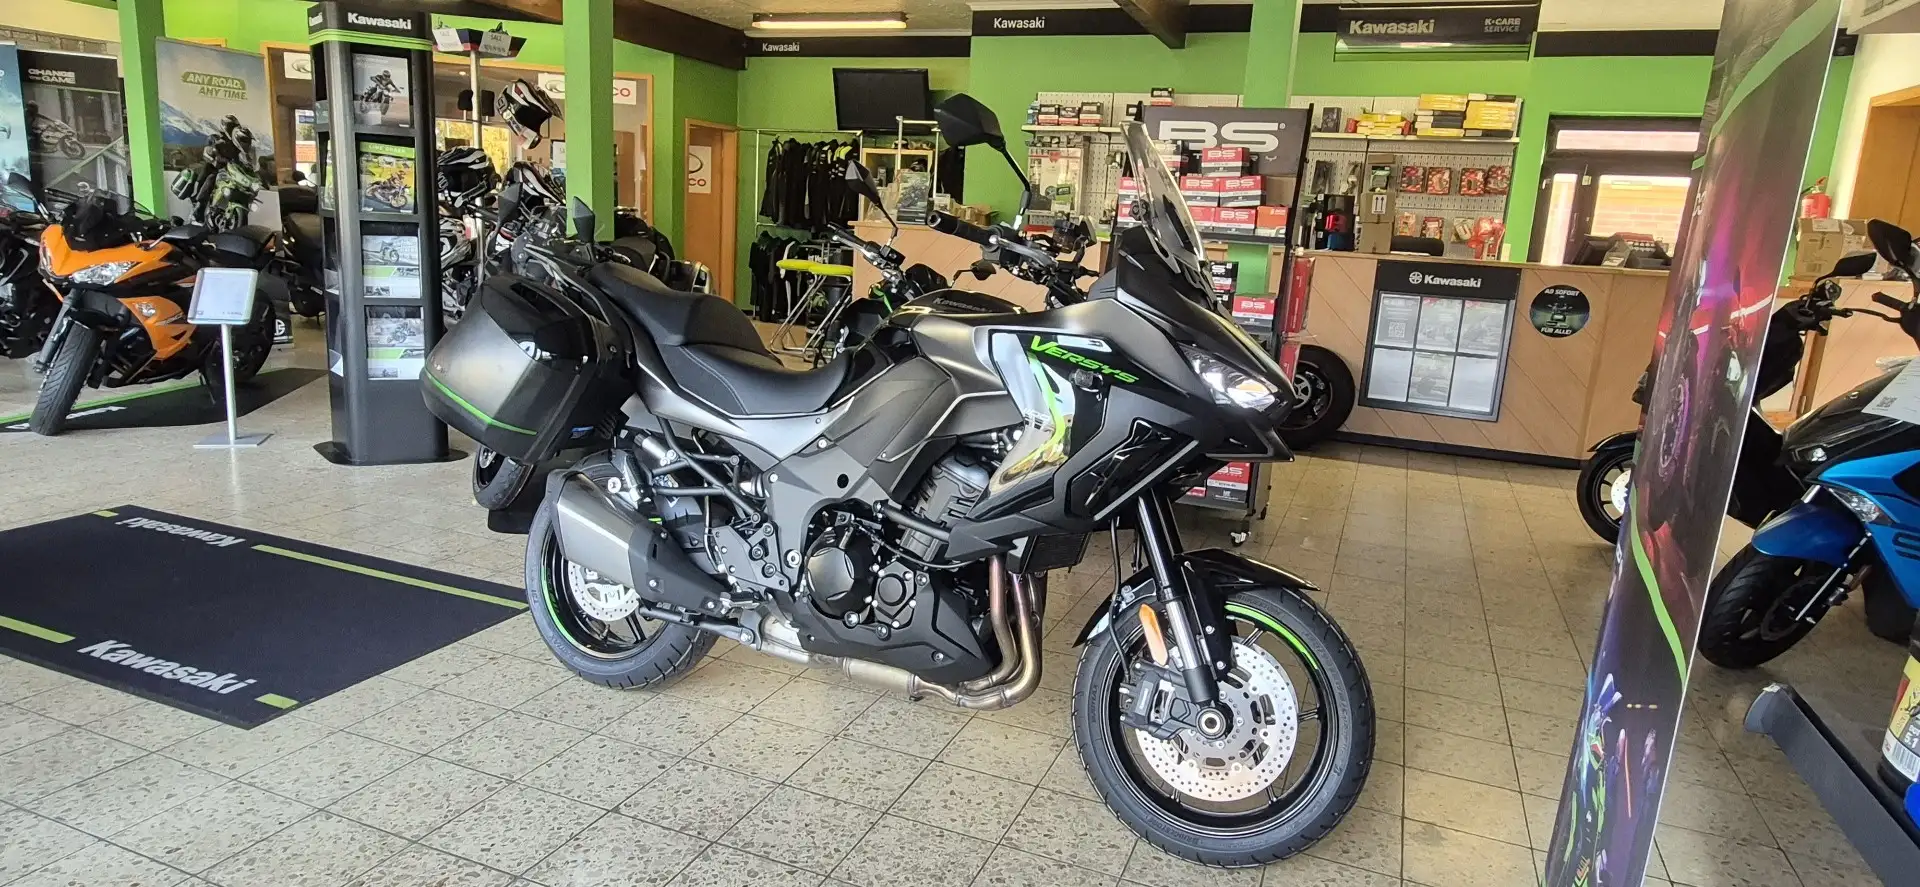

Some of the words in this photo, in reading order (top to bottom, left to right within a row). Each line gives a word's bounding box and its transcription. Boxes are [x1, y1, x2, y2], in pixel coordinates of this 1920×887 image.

[347, 12, 412, 30] Kawasaki
[992, 16, 1046, 29] Kawasaki
[1349, 19, 1435, 35] Kawasaki
[1483, 25, 1520, 33] SERVICE
[490, 33, 502, 41] SALE
[762, 41, 800, 52] Kawasaki
[28, 68, 75, 77] CHANGE
[41, 75, 76, 84] GAME
[186, 73, 210, 84] ANY
[211, 76, 243, 89] ROAD.
[198, 86, 221, 96] ANY
[223, 89, 248, 100] TIME.
[1159, 120, 1279, 153] BS
[1207, 149, 1236, 158] BS
[1185, 178, 1214, 188] BS
[1225, 178, 1255, 188] BS
[1220, 210, 1249, 219] BS
[1423, 273, 1482, 288] Kawasaki
[1555, 289, 1580, 297] SOFORT
[1241, 300, 1266, 309] BS
[1030, 335, 1140, 384] VERSYS
[115, 516, 247, 548] Kawasaki
[76, 639, 258, 695] Kawasaki
